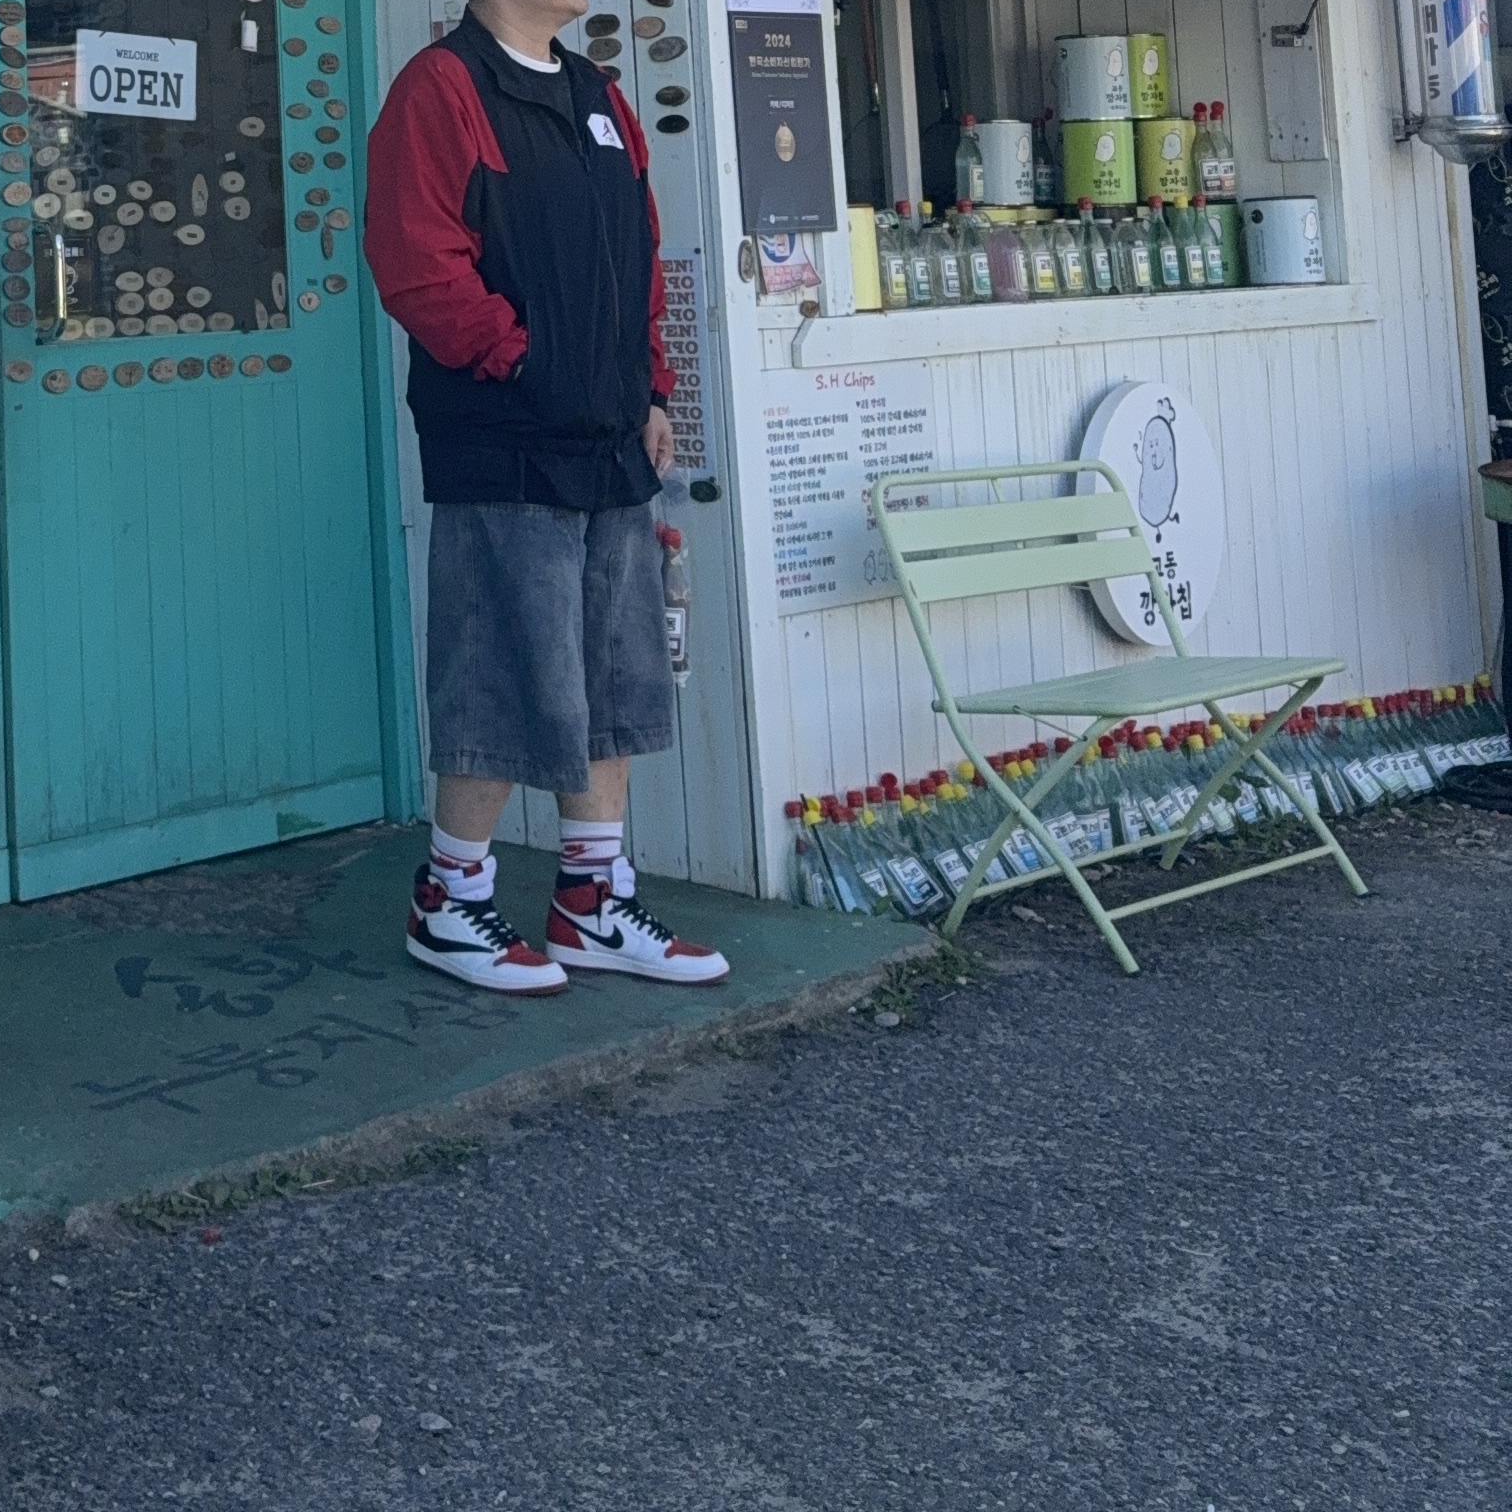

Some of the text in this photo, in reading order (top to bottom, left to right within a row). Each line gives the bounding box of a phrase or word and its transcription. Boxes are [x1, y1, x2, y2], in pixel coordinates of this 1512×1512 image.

[765, 33, 792, 48] 2024
[116, 48, 160, 63] WELCOME
[90, 64, 183, 110] OPEN
[844, 372, 876, 392] Chips
